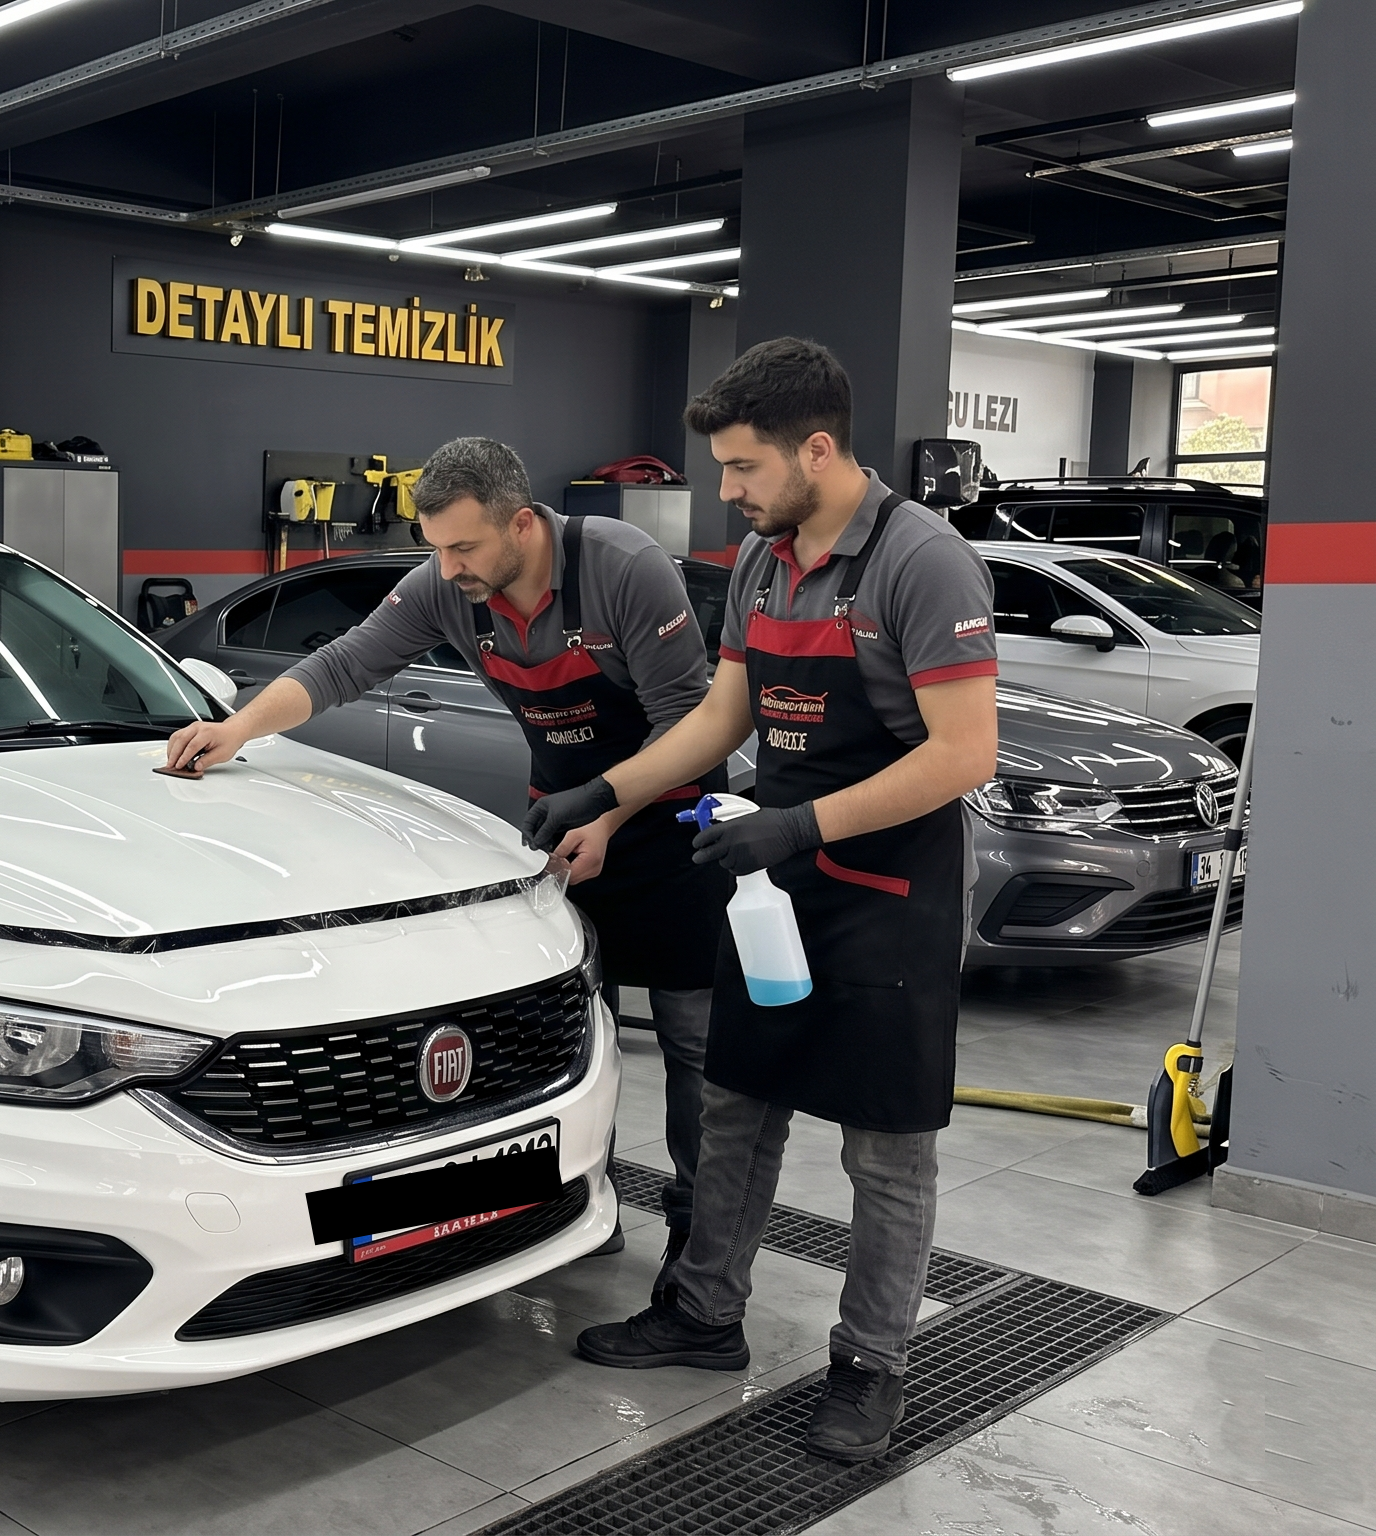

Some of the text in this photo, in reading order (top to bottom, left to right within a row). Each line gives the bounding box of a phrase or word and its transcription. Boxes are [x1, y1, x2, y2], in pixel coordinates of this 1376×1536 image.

[135, 276, 505, 367] DETAYLI TEMİZLİK
[972, 393, 1019, 433] LEZI
[433, 1046, 464, 1085] FIAT
